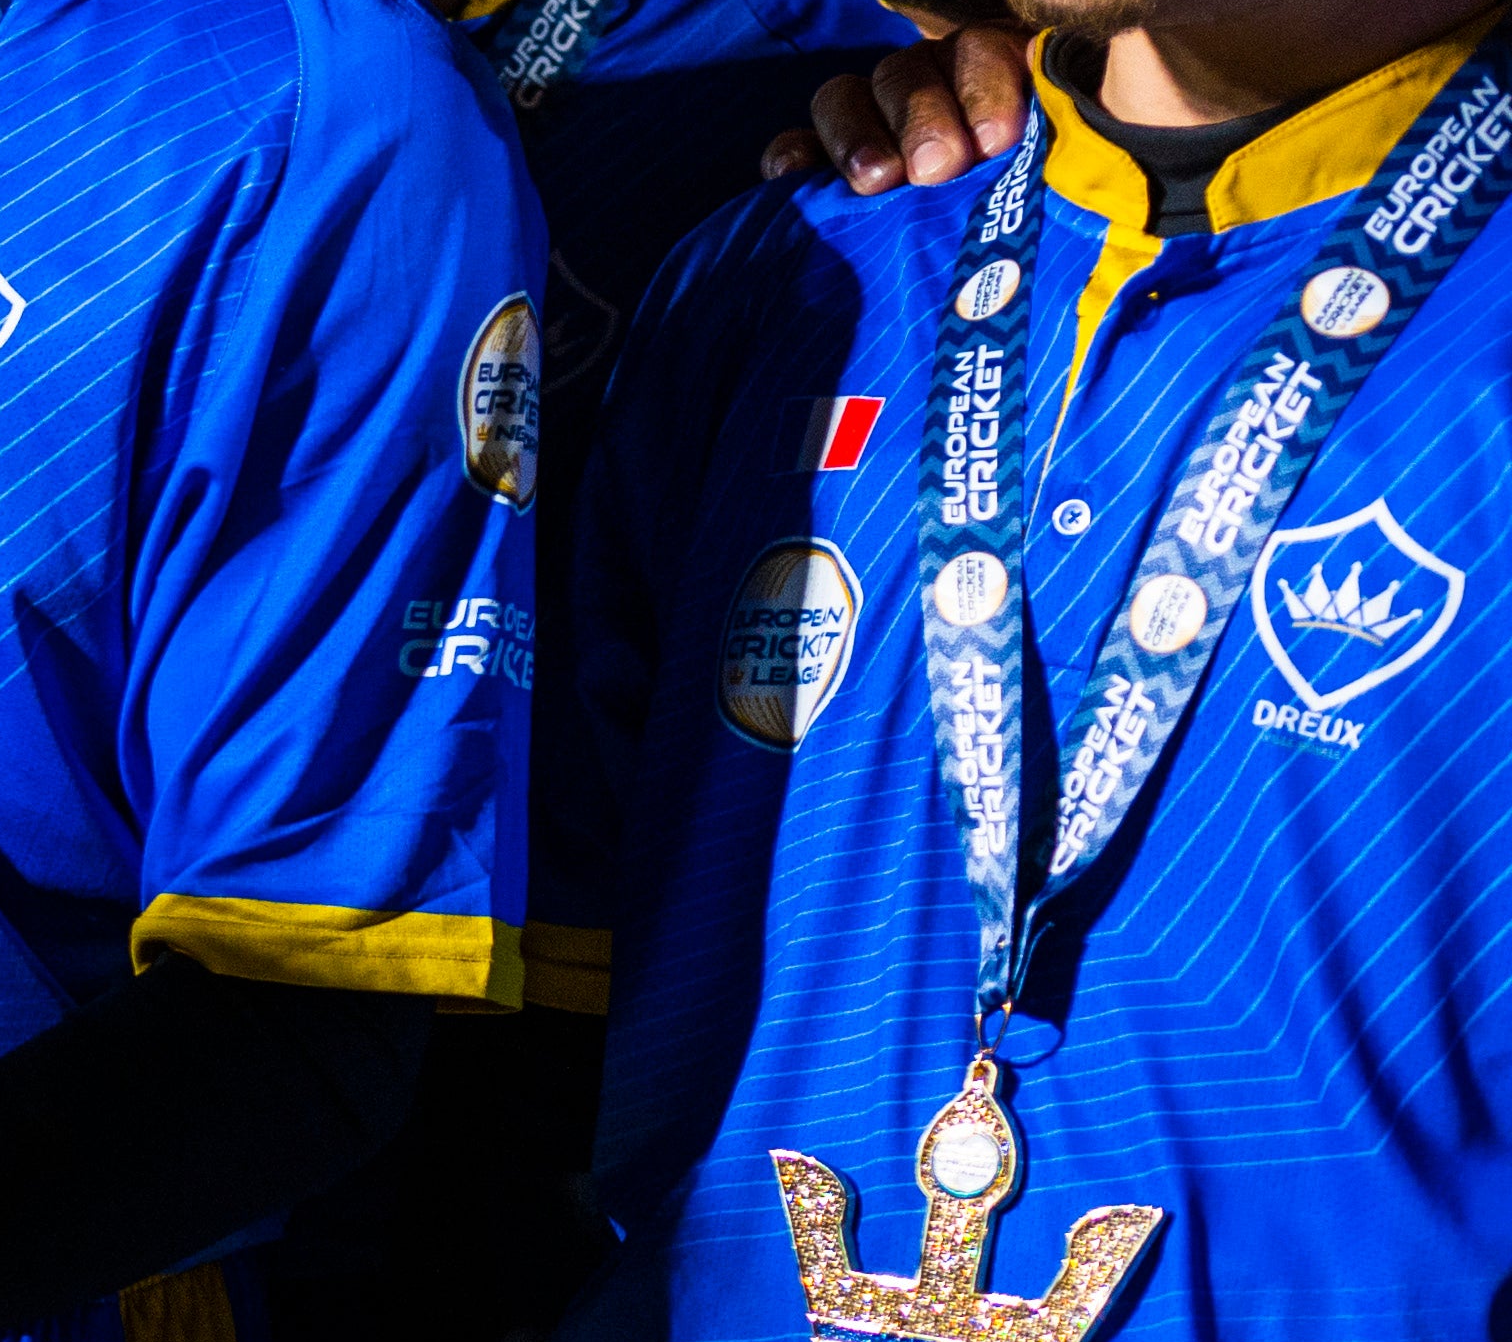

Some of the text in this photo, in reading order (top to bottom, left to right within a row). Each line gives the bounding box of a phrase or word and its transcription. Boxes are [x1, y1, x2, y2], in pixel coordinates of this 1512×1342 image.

[1363, 75, 1500, 242] EUROPEAN
[1392, 93, 1512, 254] CRICKET
[973, 267, 988, 317] EUROPEAN
[981, 265, 997, 316] CRICKET
[1315, 269, 1355, 325] EUROPEAN
[1324, 270, 1368, 330] CRICKET
[942, 351, 975, 525] EUROPEAN
[968, 344, 1004, 521] CRICKET
[1177, 352, 1295, 547] EUROPEAN
[1204, 360, 1322, 554] CRICKET
[950, 661, 989, 857] EUROPEAN
[972, 656, 1006, 854] CRICKET
[1048, 681, 1155, 877] CRICKET
[1252, 699, 1365, 751] DREUX
